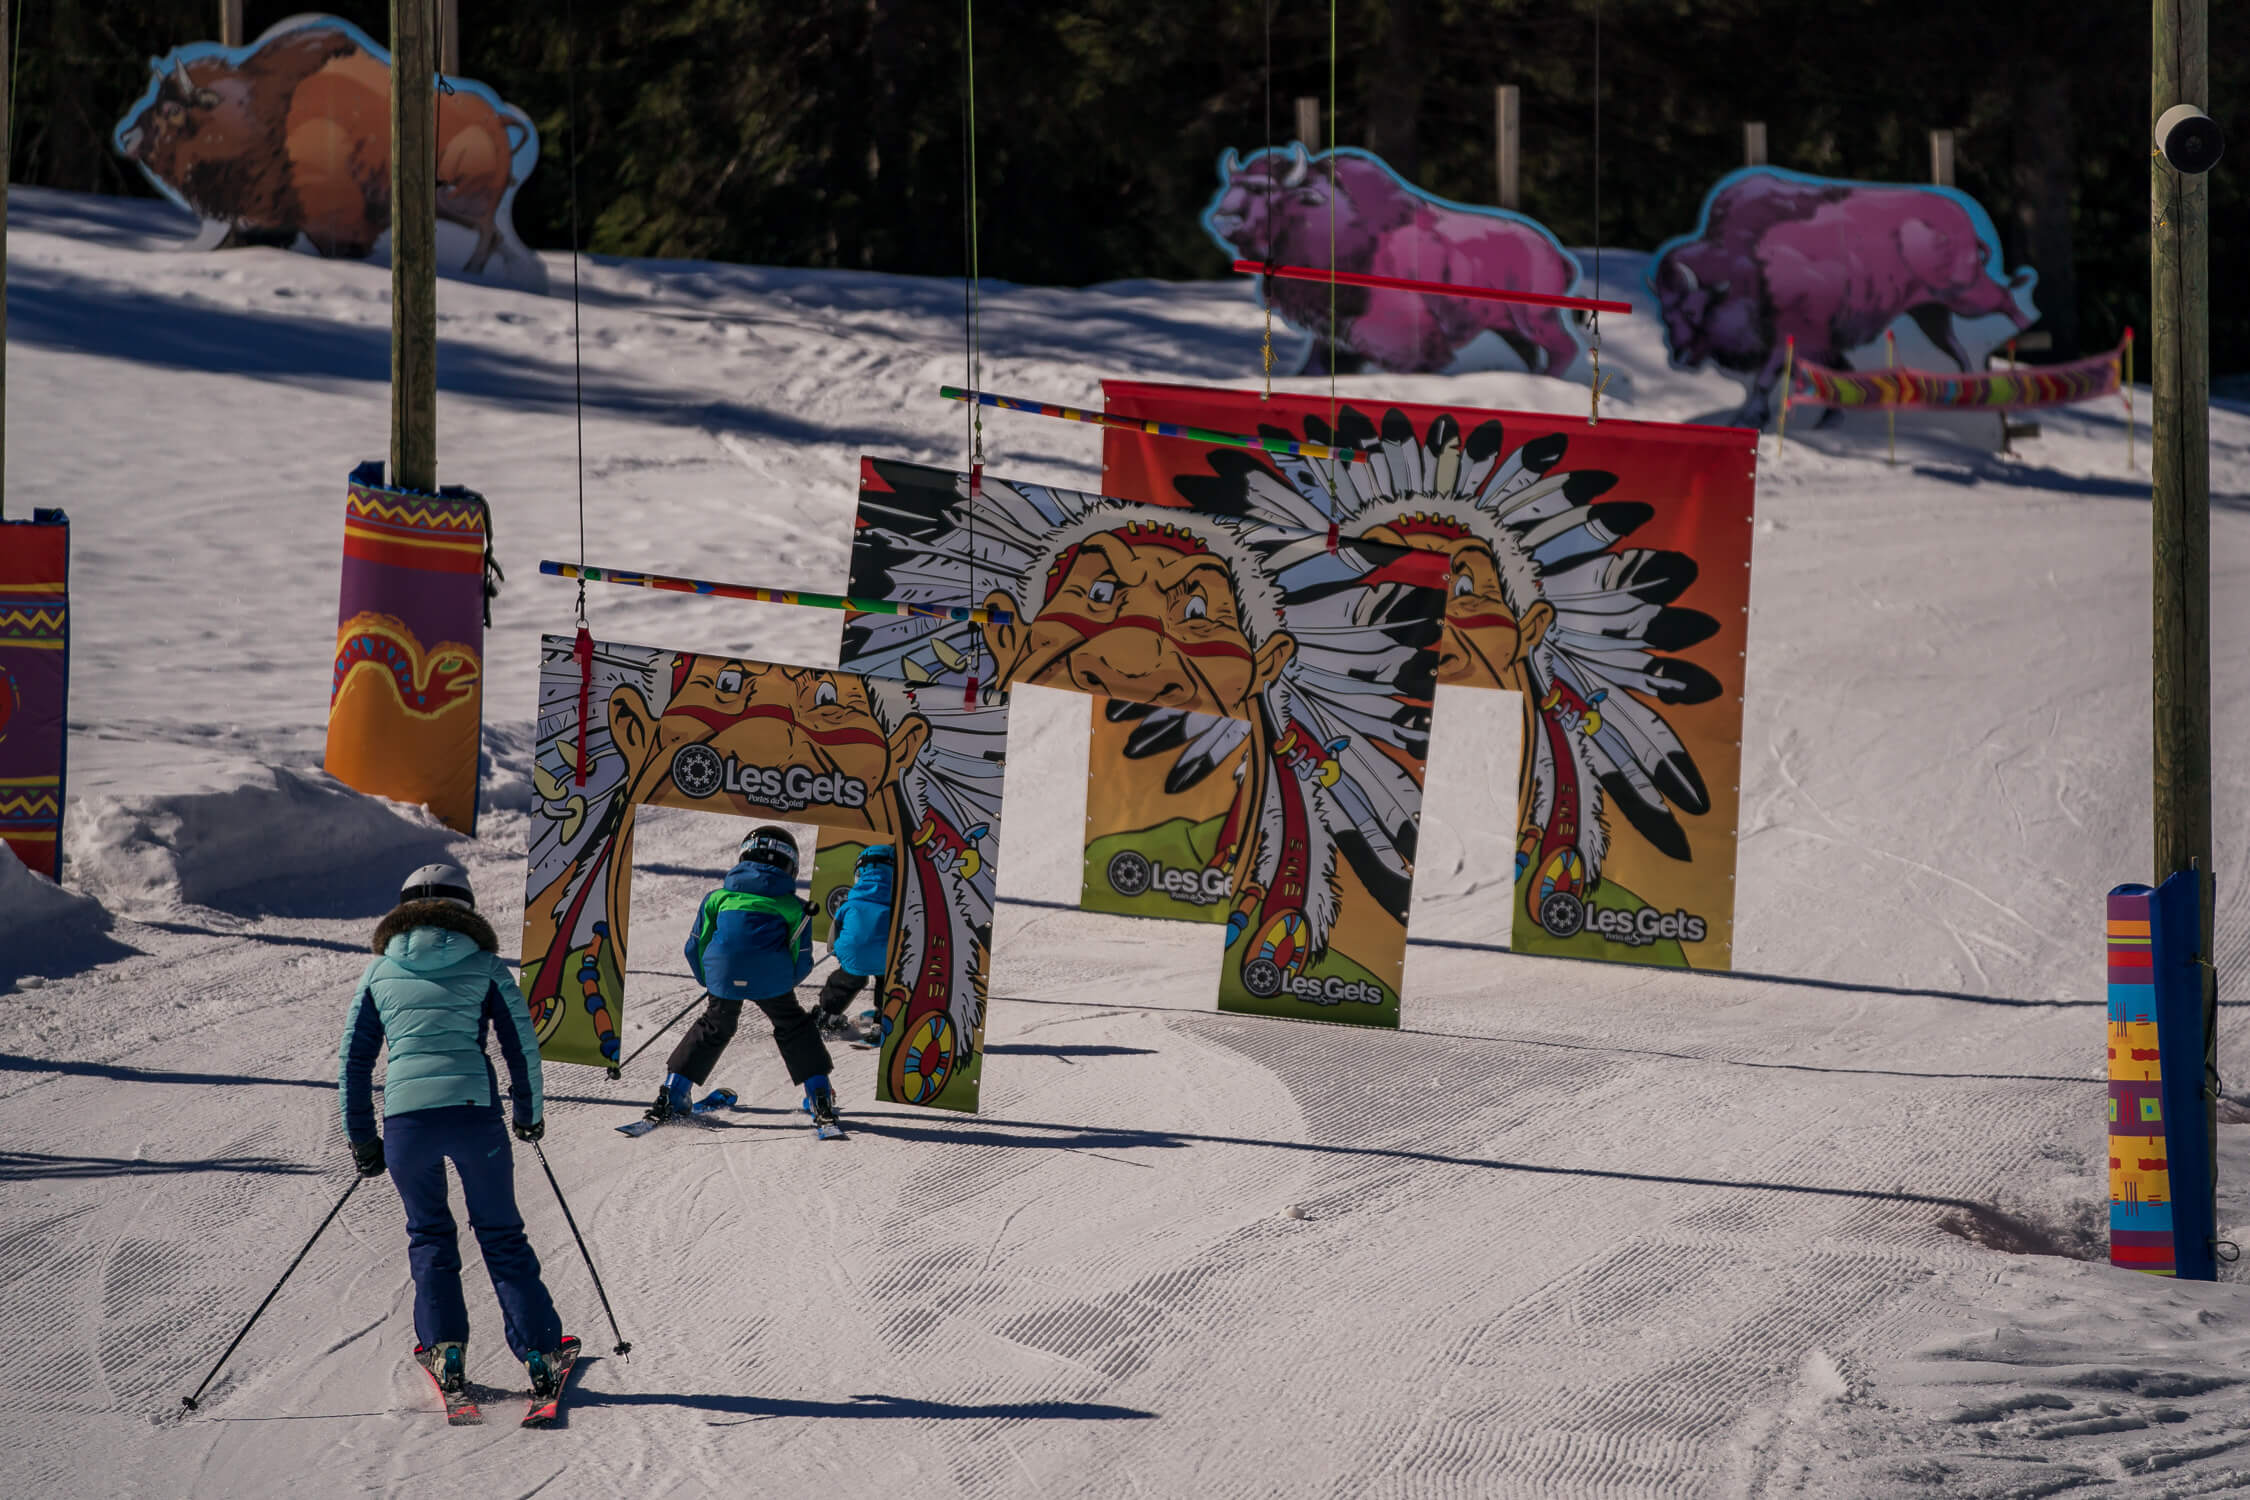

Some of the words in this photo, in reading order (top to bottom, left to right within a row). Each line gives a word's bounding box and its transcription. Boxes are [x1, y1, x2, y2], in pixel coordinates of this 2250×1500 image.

[725, 758, 782, 796] Les
[785, 766, 867, 807] Gets
[1152, 863, 1199, 893] Les
[1586, 903, 1634, 933] Les
[1636, 907, 1705, 940] Gets
[1281, 969, 1322, 996] Les
[1324, 976, 1383, 1004] Gets
